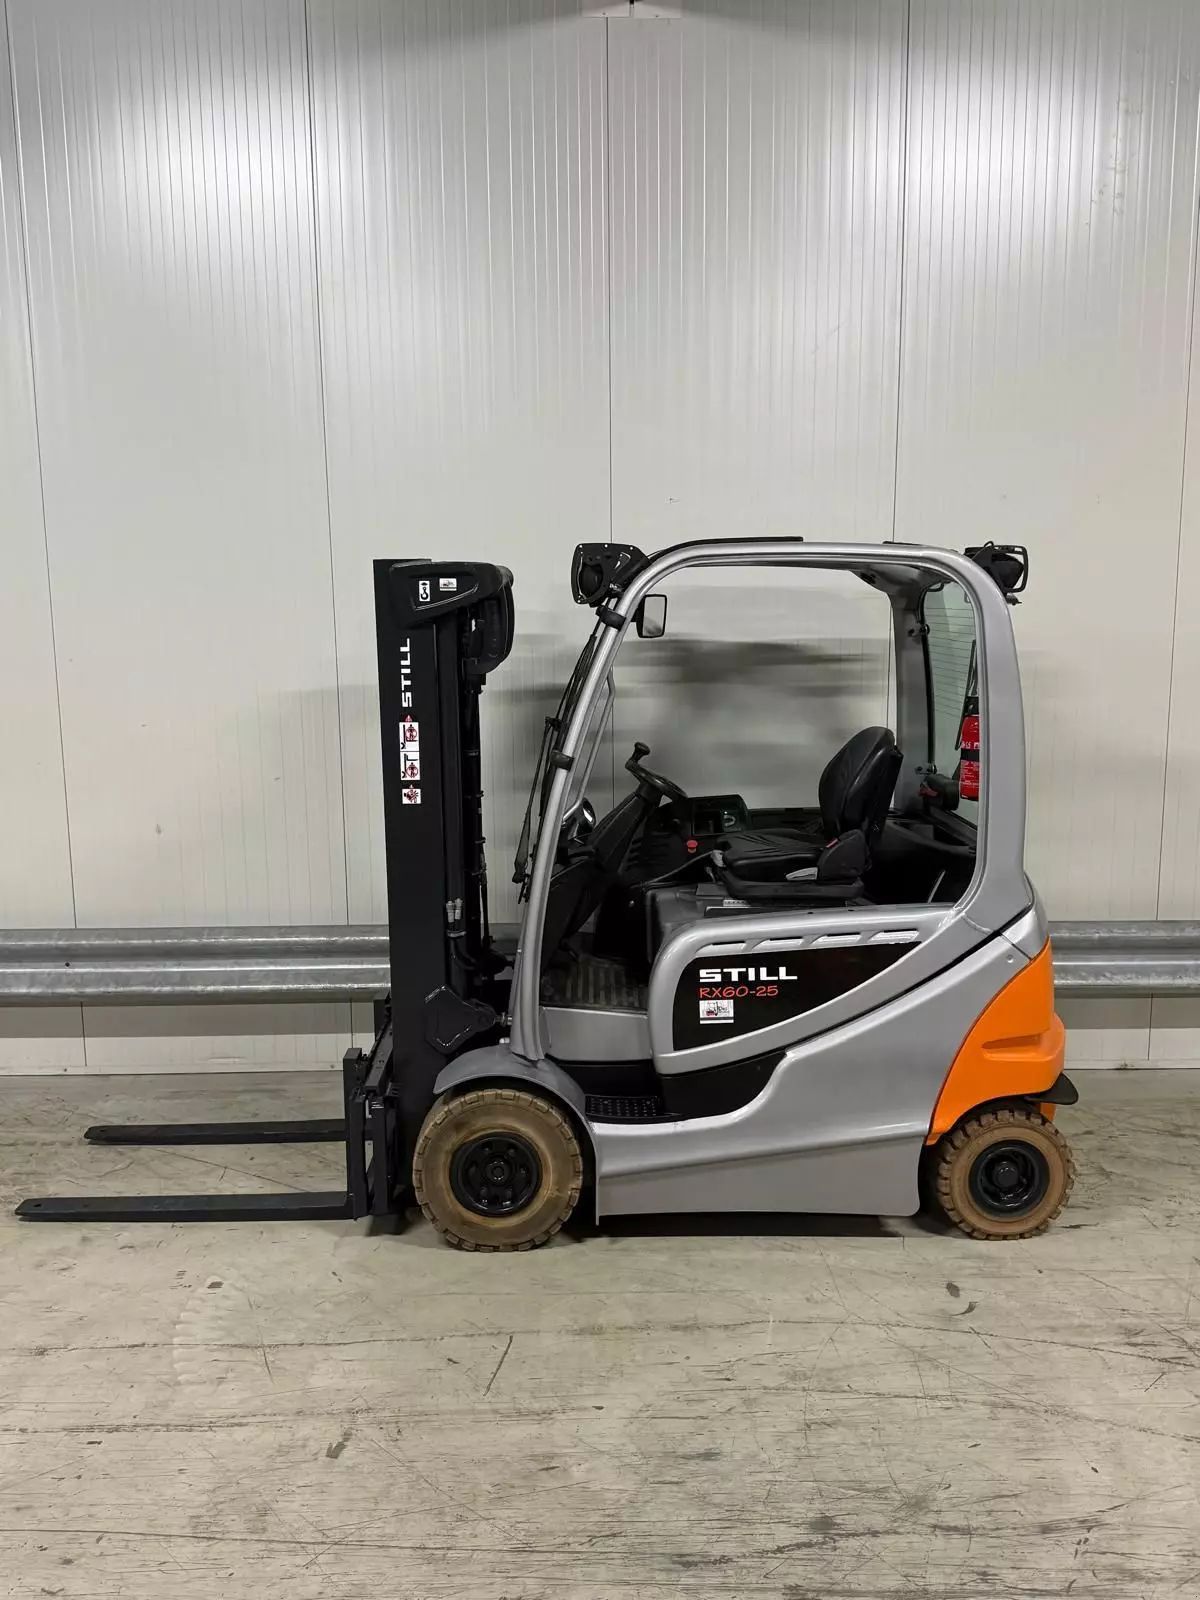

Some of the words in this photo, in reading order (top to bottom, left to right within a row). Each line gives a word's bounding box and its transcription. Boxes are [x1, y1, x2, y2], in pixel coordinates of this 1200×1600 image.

[399, 637, 413, 708] STILL
[699, 966, 798, 983] STILL
[699, 985, 779, 998] RX60-25
